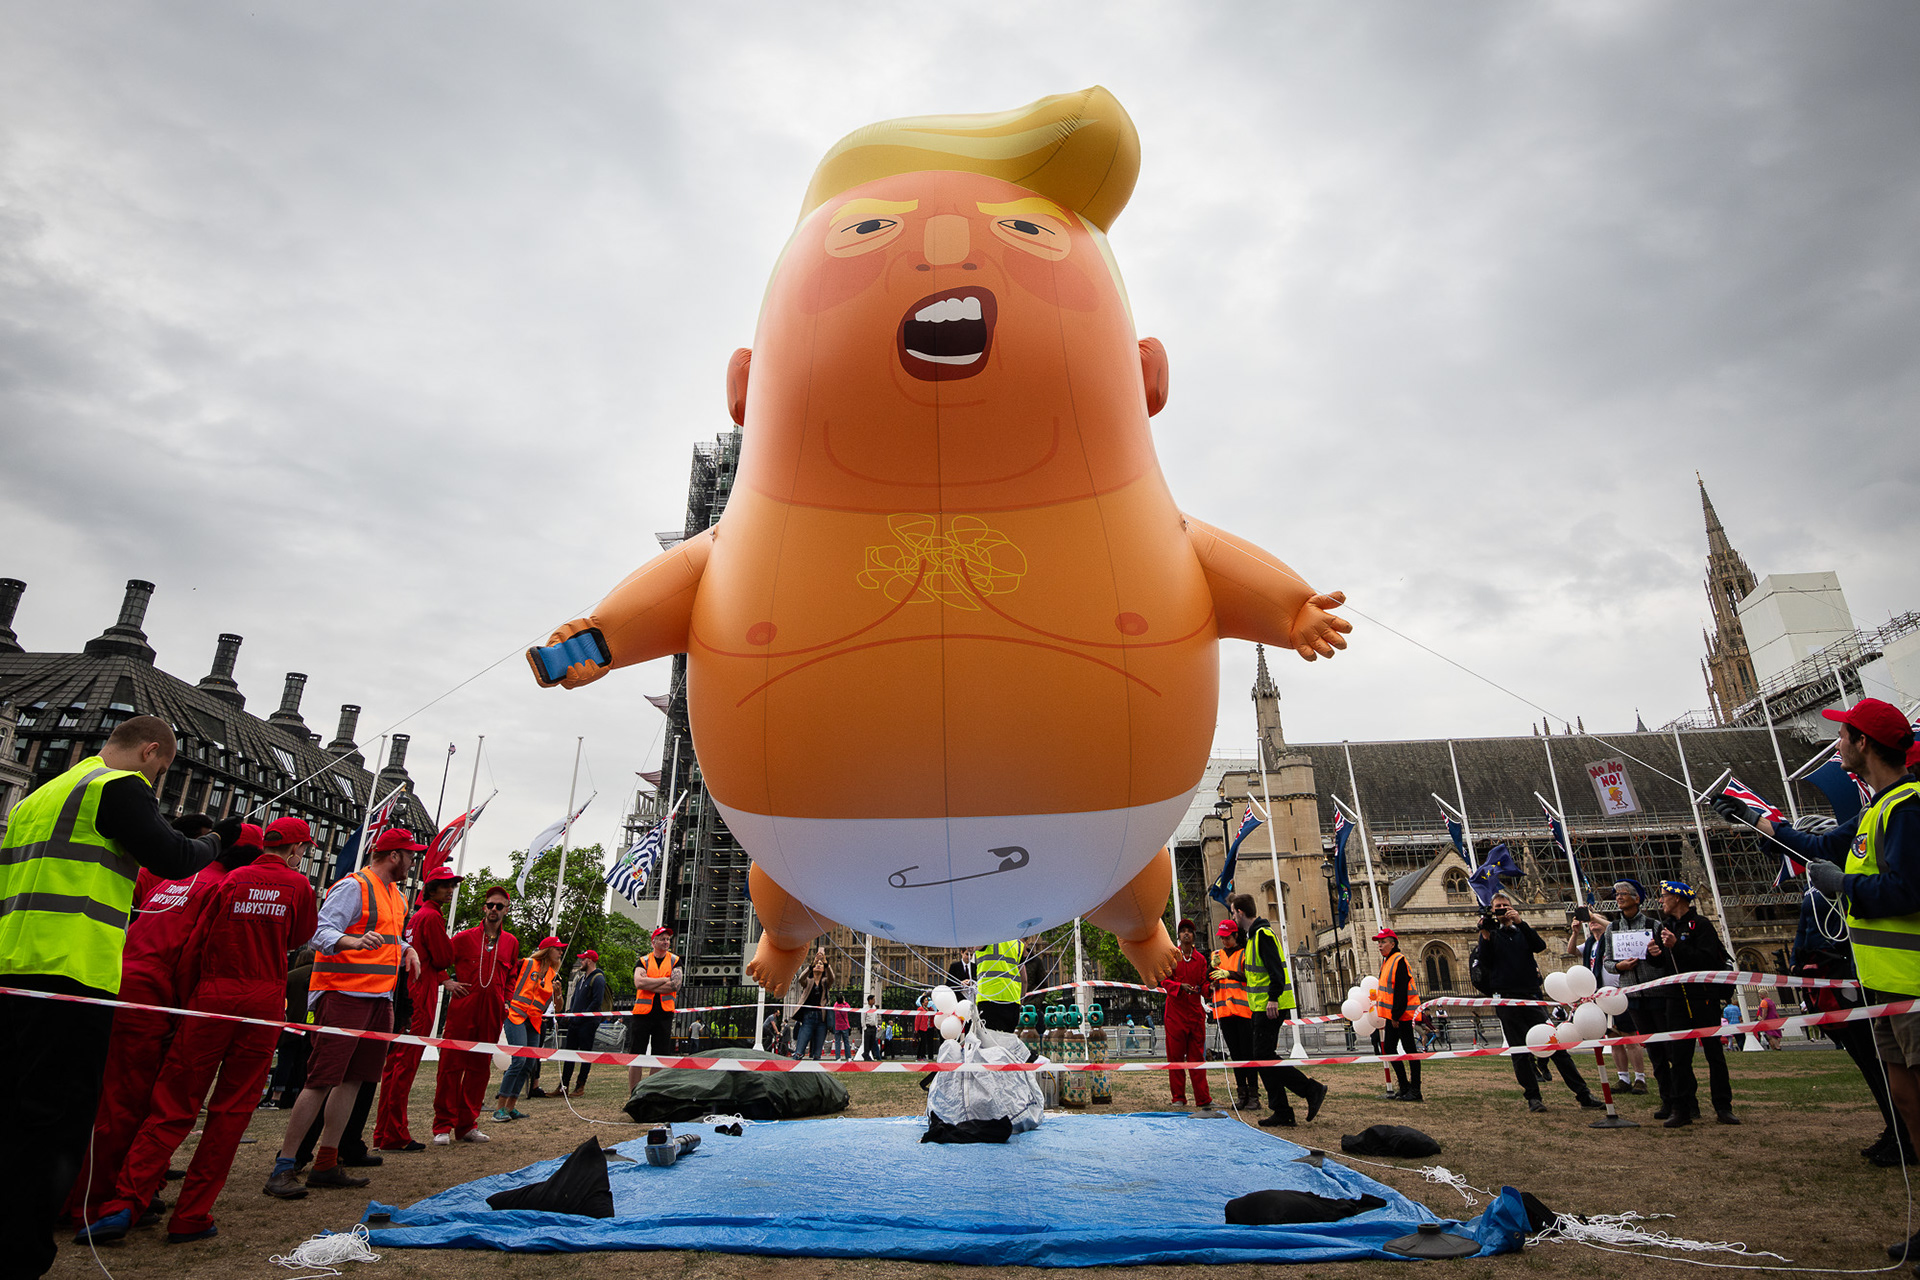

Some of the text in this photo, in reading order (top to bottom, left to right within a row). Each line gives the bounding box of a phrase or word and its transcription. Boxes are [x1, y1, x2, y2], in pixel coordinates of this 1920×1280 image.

[1600, 772, 1622, 787] NO!
[248, 888, 280, 901] TRUMP
[233, 901, 287, 917] BABYSITTER
